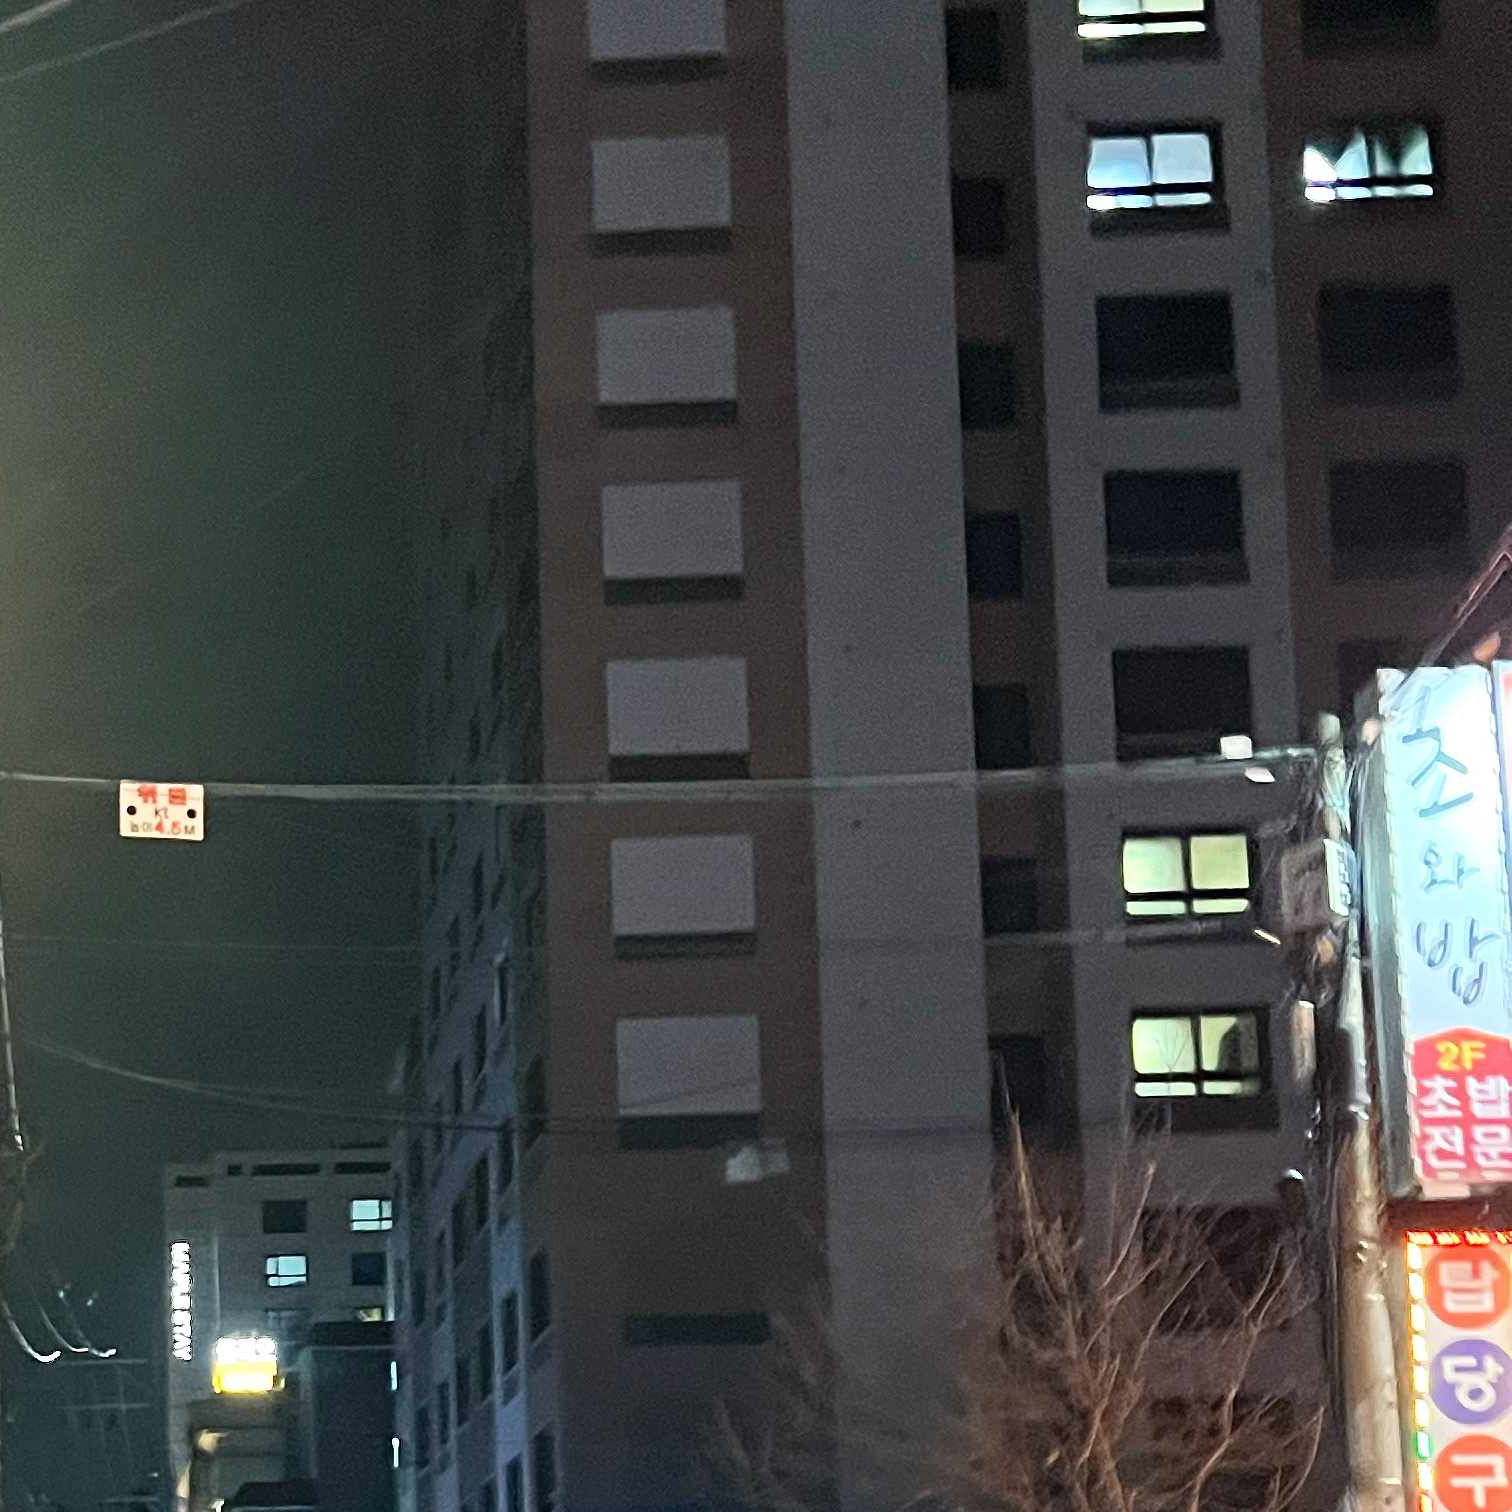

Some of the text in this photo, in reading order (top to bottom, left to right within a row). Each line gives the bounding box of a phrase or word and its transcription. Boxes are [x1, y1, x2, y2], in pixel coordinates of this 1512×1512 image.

[1434, 1041, 1486, 1071] 2F
[1417, 1076, 1512, 1120] 초밥
[1422, 1124, 1512, 1171] 전문
